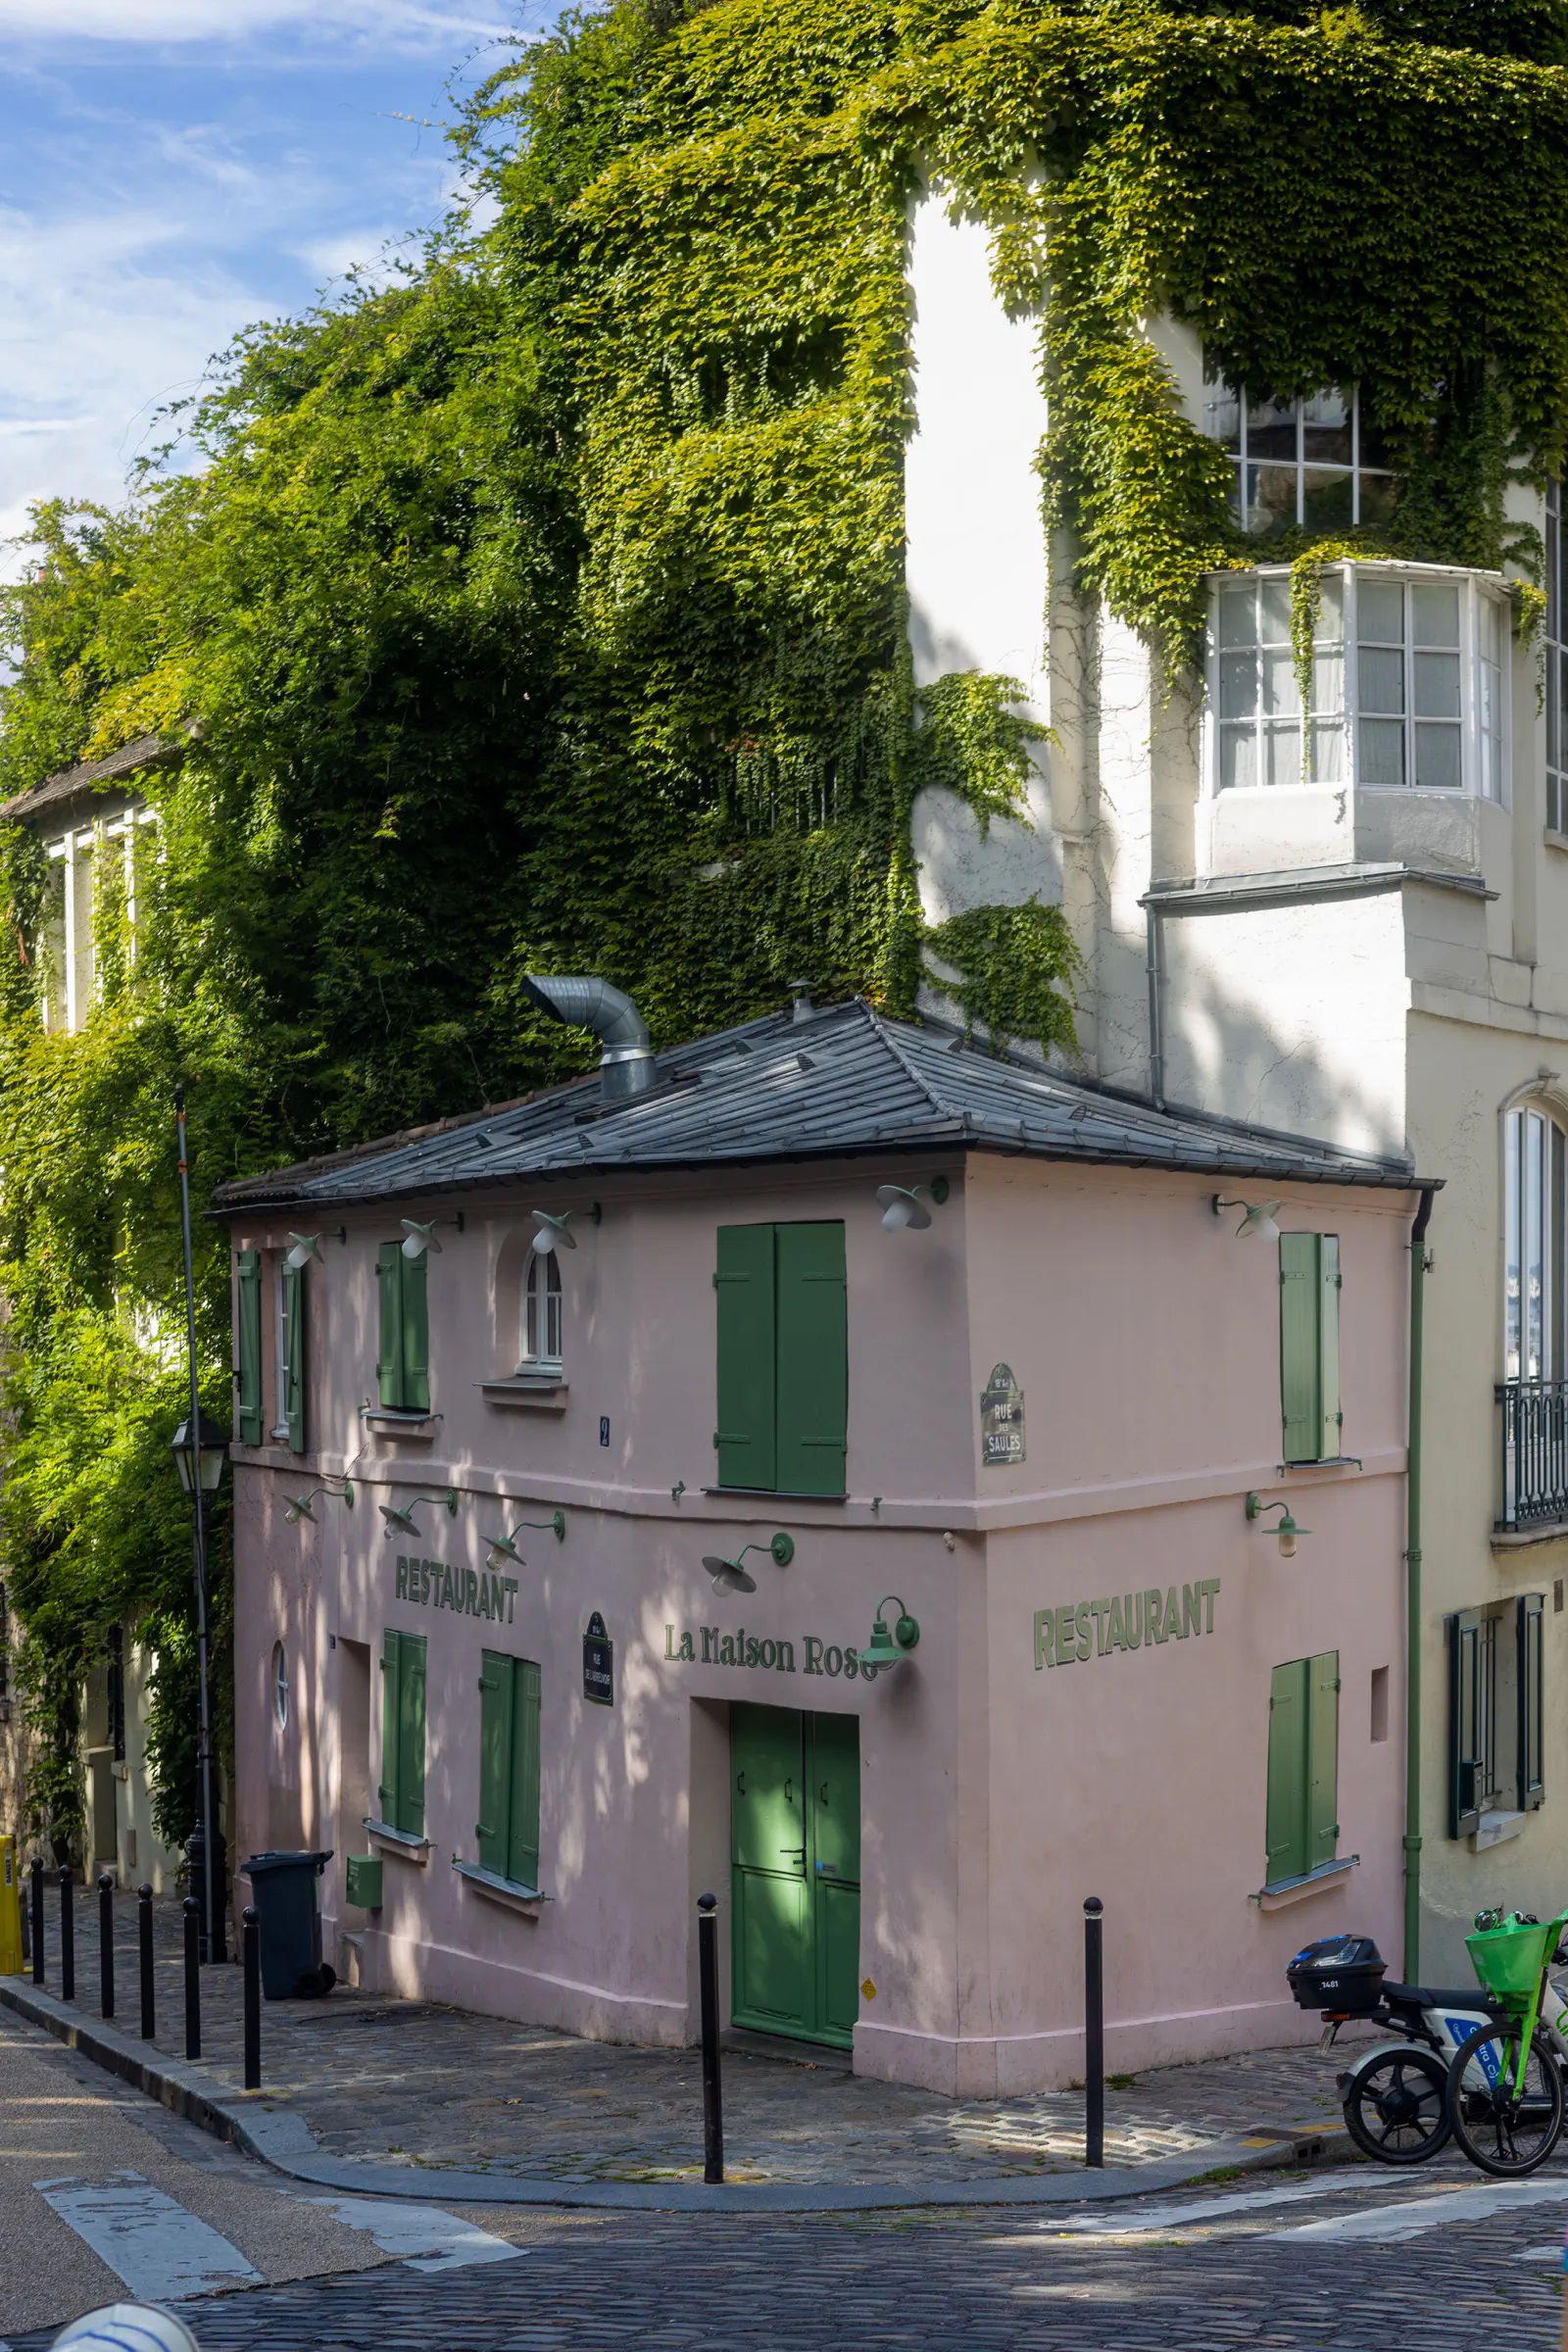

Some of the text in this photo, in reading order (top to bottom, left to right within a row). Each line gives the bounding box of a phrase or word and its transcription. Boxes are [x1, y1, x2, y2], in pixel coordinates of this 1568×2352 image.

[995, 1403, 1012, 1420] RUE
[988, 1435, 1020, 1452] SAULES
[396, 1555, 518, 1624] RESTAURANT
[1034, 1578, 1221, 1671] RESTAURANT
[664, 1624, 696, 1662] La
[699, 1626, 796, 1673] Maison
[1321, 1980, 1339, 1988] 1481
